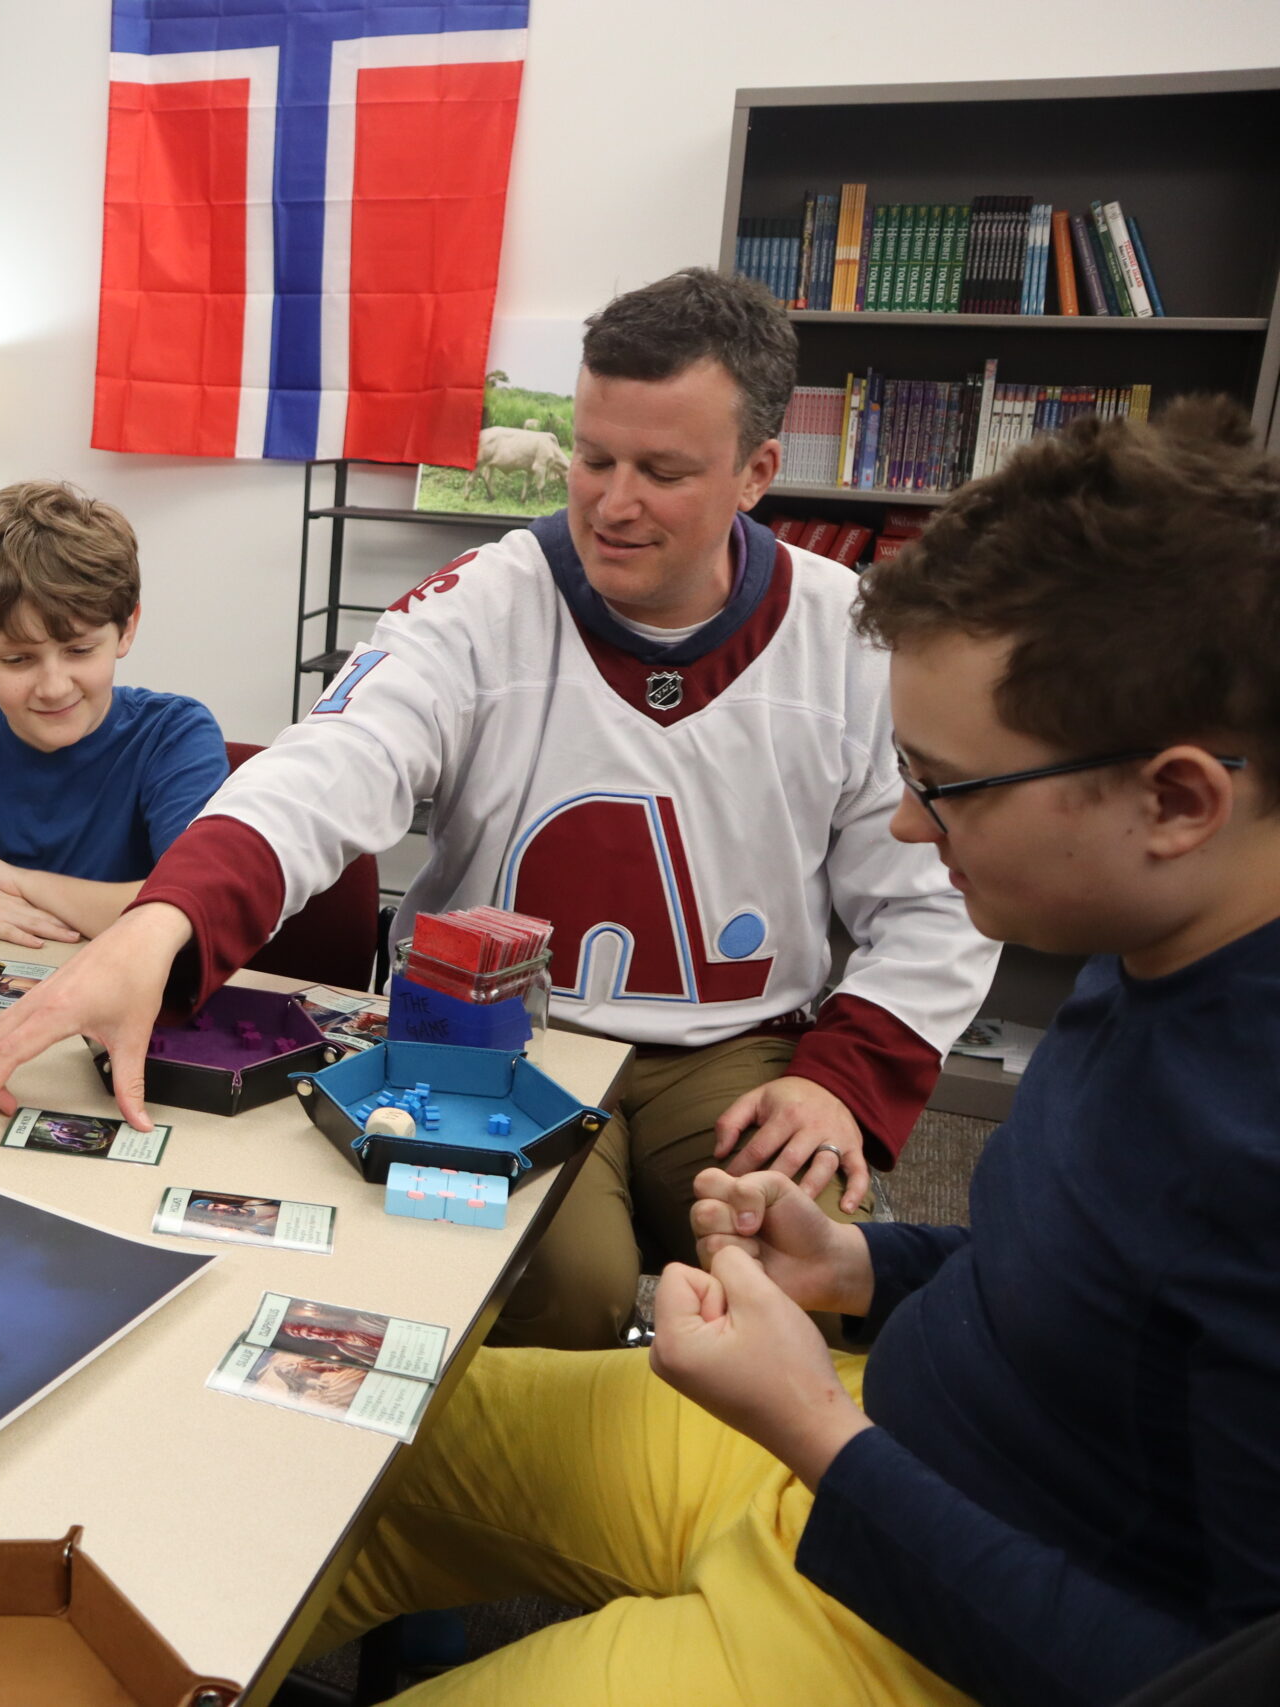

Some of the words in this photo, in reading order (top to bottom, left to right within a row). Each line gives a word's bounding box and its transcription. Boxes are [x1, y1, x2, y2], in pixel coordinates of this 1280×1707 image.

[867, 266, 878, 302] TOLKIEN
[881, 266, 892, 302] TOLKIEN
[895, 266, 906, 302] TOLKIEN
[908, 266, 920, 302] TOLKIEN
[922, 267, 933, 302] TOLKIEN
[936, 267, 947, 303] TOLKIEN
[951, 267, 962, 303] TOLKIEN
[655, 683, 676, 701] NHL
[399, 991, 431, 1014] THE
[405, 1018, 449, 1040] GAME
